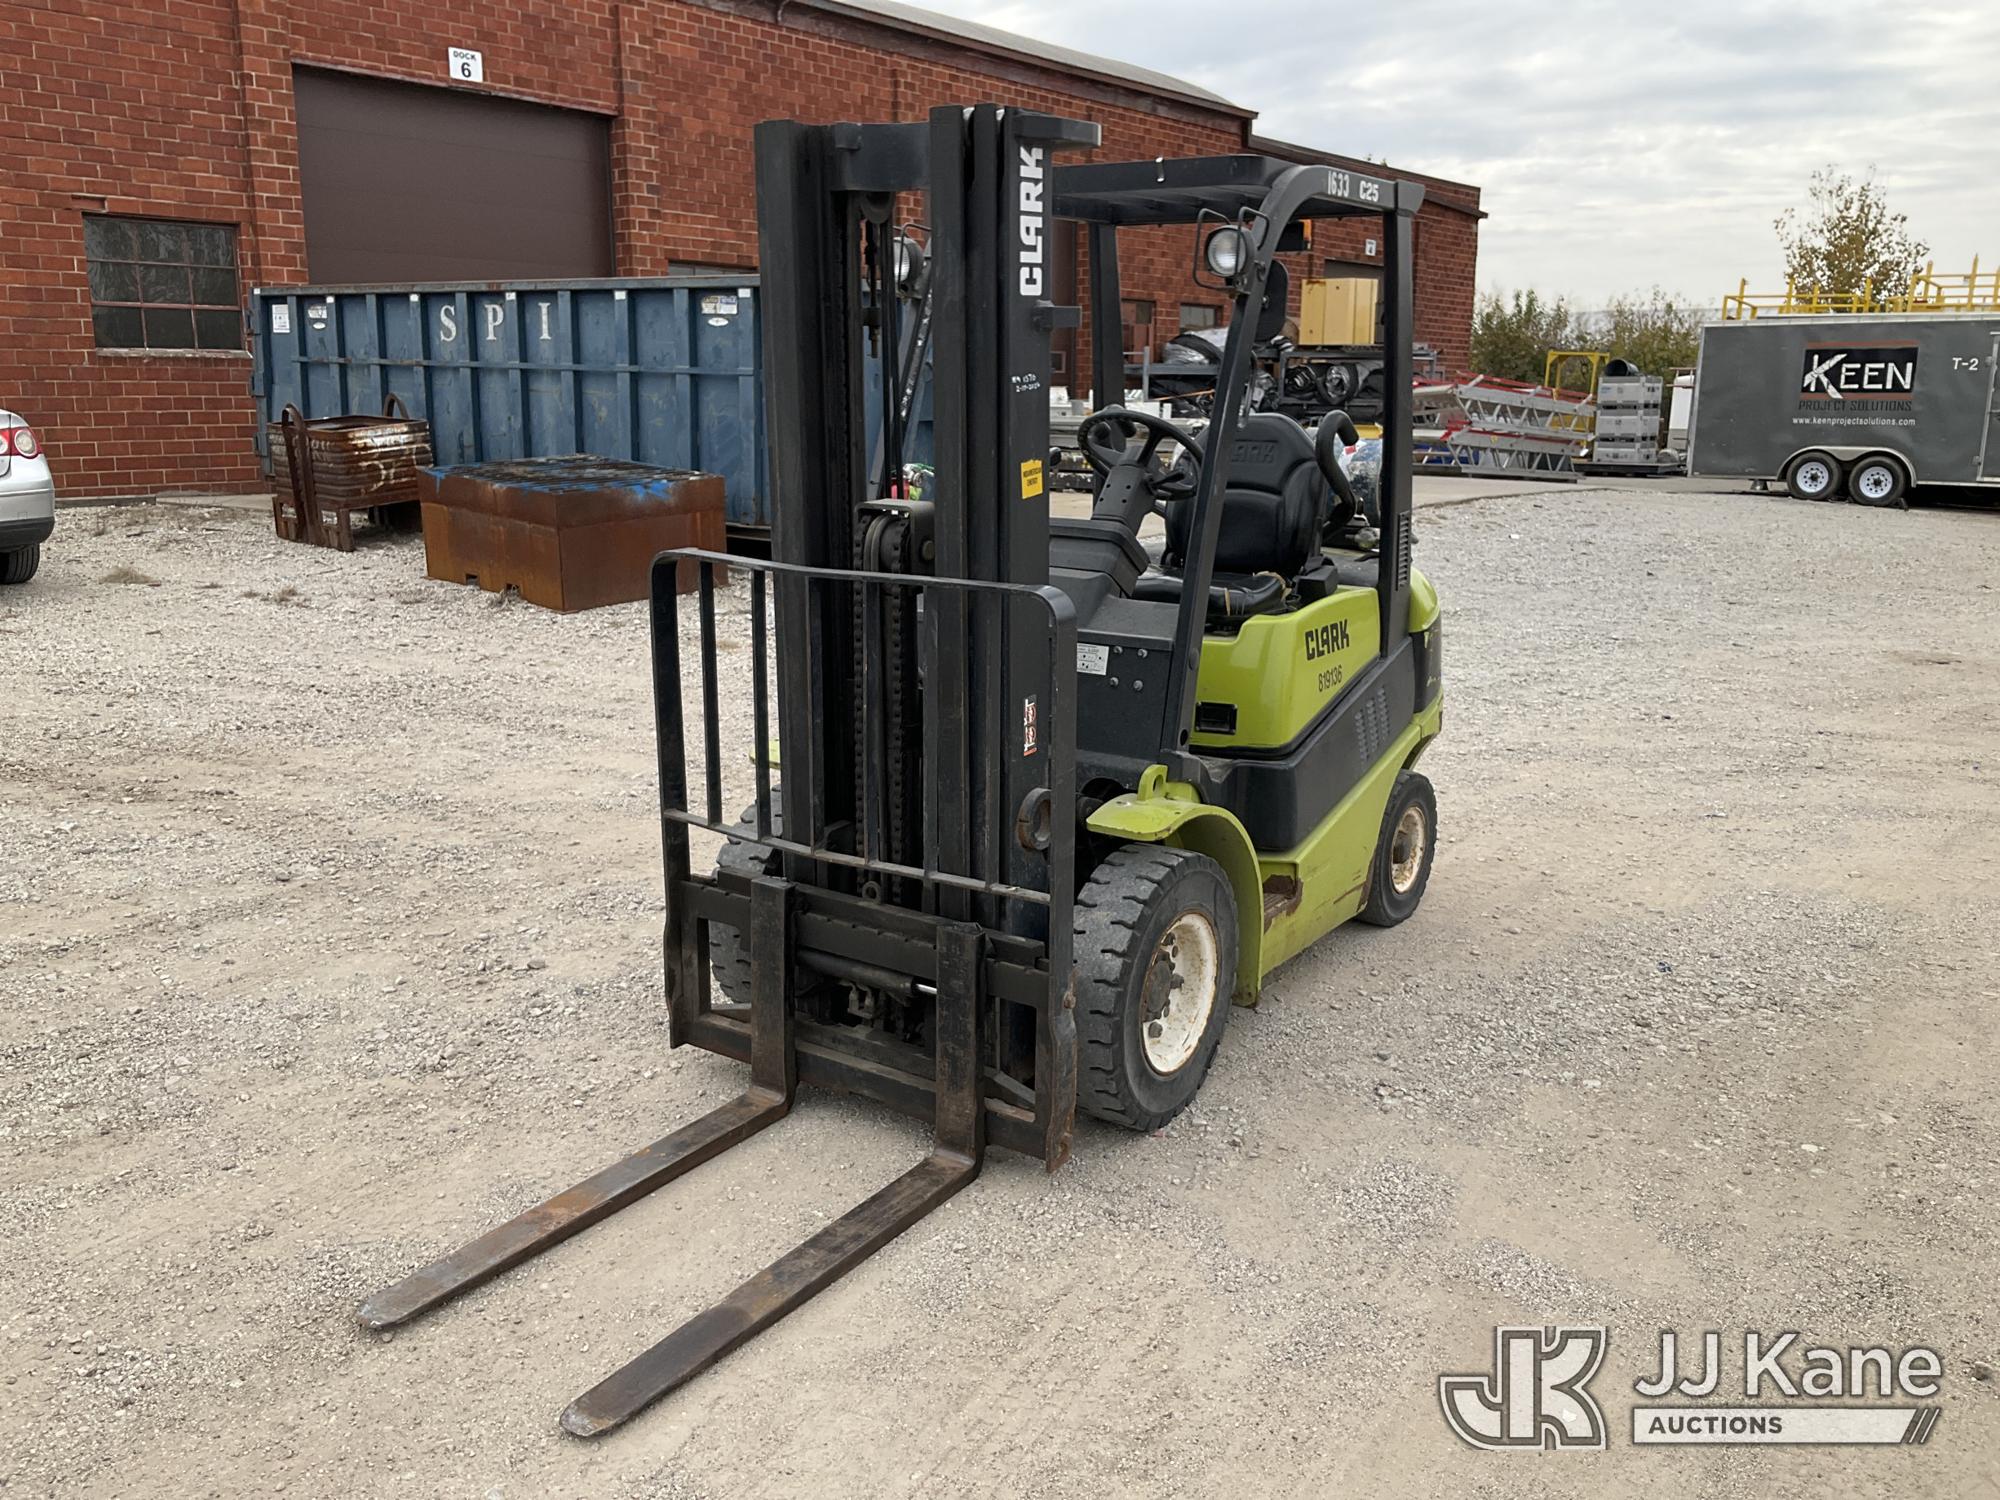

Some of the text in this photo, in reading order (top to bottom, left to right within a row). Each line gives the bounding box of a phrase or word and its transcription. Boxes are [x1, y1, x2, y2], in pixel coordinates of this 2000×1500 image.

[453, 50, 476, 61] DOCK
[461, 62, 471, 78] 6
[1327, 170, 1379, 203] 1633 C25
[1019, 145, 1044, 296] CLARK
[1952, 357, 1979, 371] T-2
[1803, 353, 1913, 399] KEEN
[1798, 400, 1912, 412] PROJECT SOLUTIONS
[1792, 416, 1916, 427] www.keenprojectsolutions.com
[1305, 618, 1350, 661] CLARK
